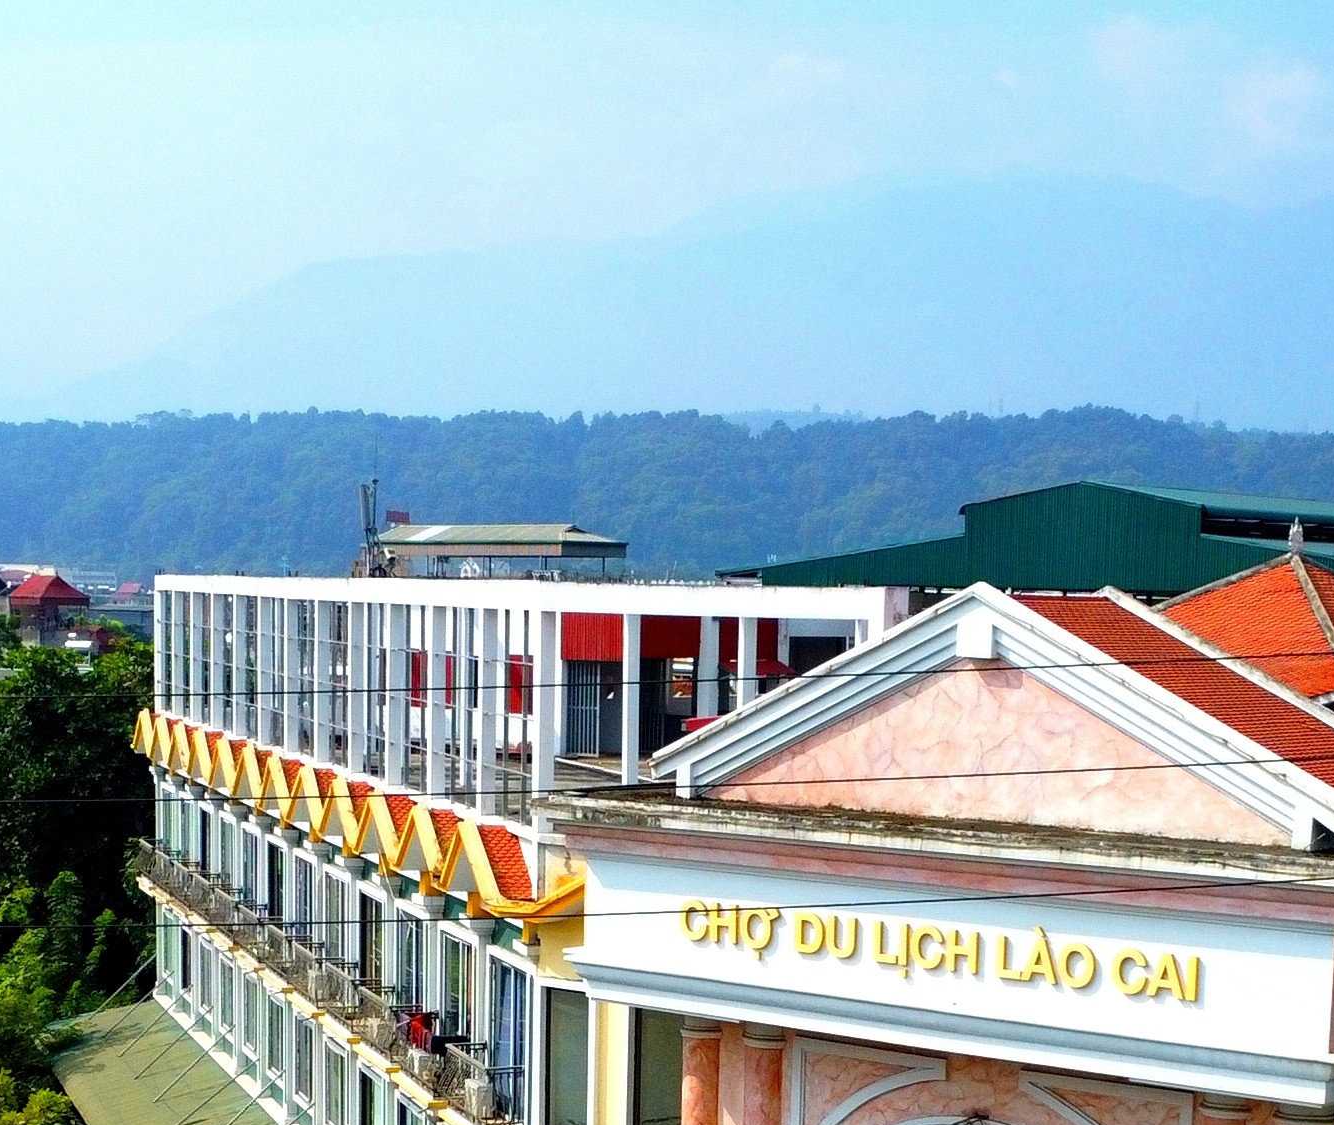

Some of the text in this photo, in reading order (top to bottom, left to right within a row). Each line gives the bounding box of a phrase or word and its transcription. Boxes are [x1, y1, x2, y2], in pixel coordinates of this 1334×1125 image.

[678, 899, 1201, 1002] CHỢ DU LỊCH LÀO CAI
